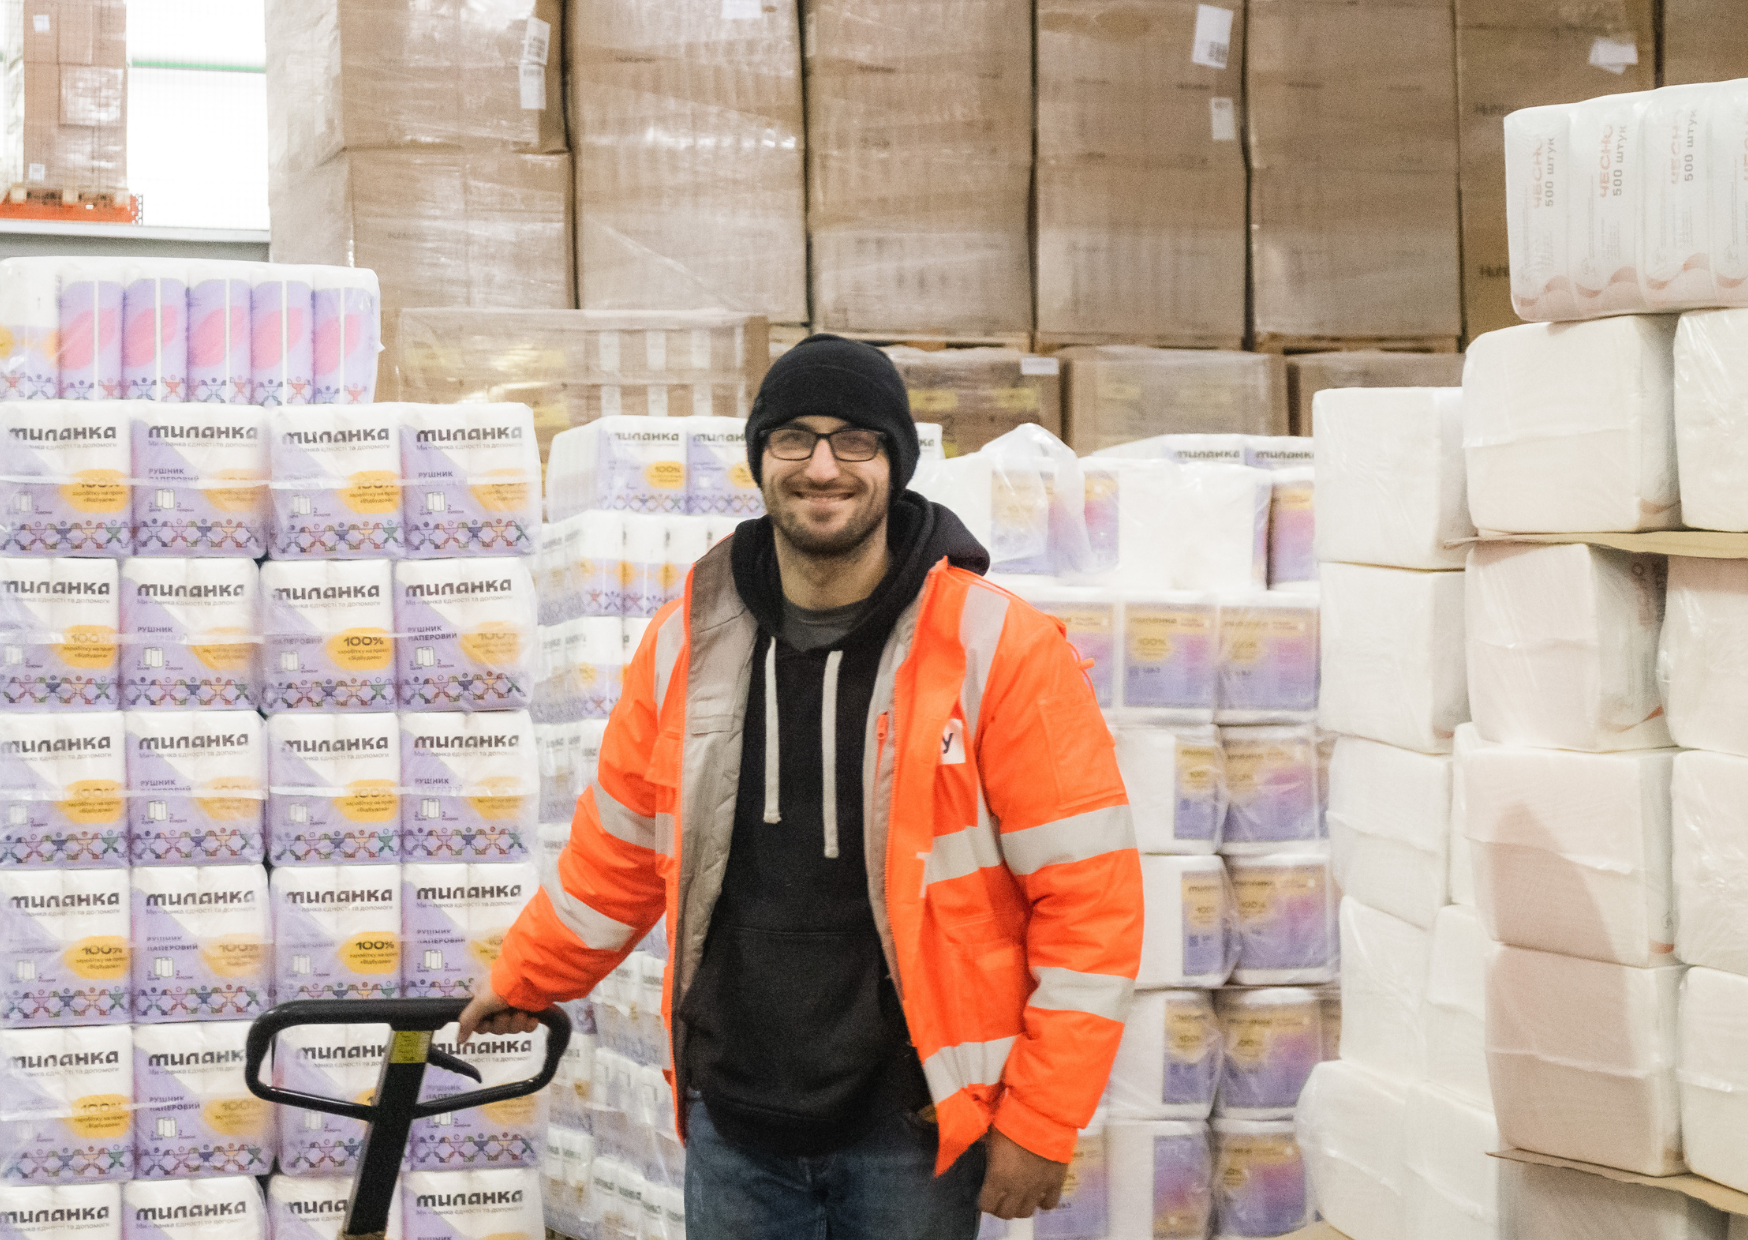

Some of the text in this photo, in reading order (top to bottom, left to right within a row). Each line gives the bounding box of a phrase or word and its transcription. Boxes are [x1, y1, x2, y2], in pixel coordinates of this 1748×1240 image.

[1684, 108, 1697, 181] 500 штук
[1613, 125, 1628, 196] 500 штук
[1545, 137, 1556, 207] 500 штук
[343, 636, 384, 647] 100%
[356, 941, 394, 950] 100%
[148, 1050, 245, 1066] миланк
[299, 1045, 387, 1060] миланк
[286, 1199, 348, 1214] мила
